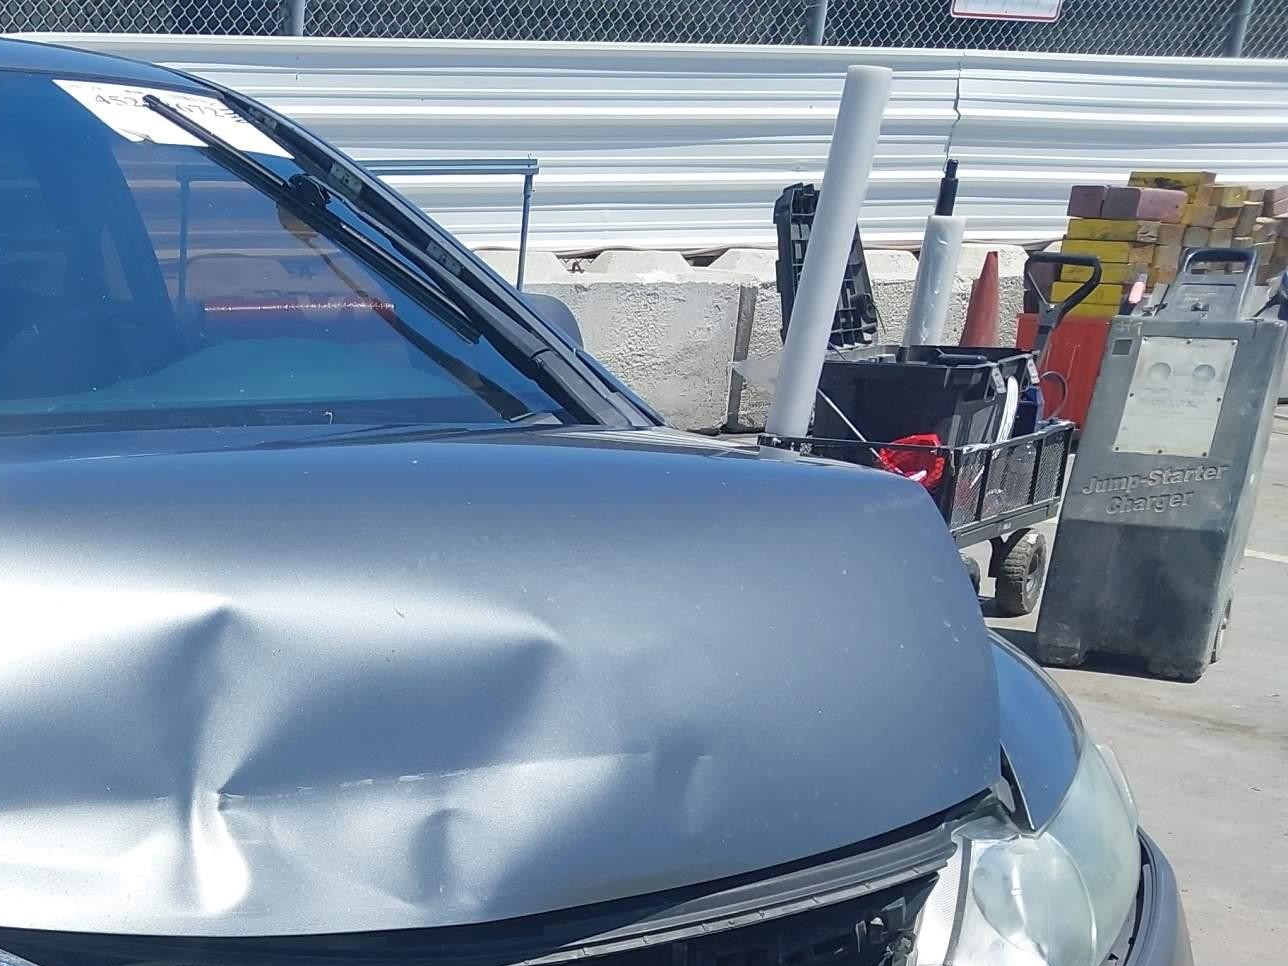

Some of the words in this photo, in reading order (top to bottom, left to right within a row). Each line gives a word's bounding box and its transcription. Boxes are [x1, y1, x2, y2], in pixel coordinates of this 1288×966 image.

[95, 94, 225, 118] 452672
[1082, 464, 1230, 494] Jump-Starter
[1105, 491, 1194, 514] Charger
